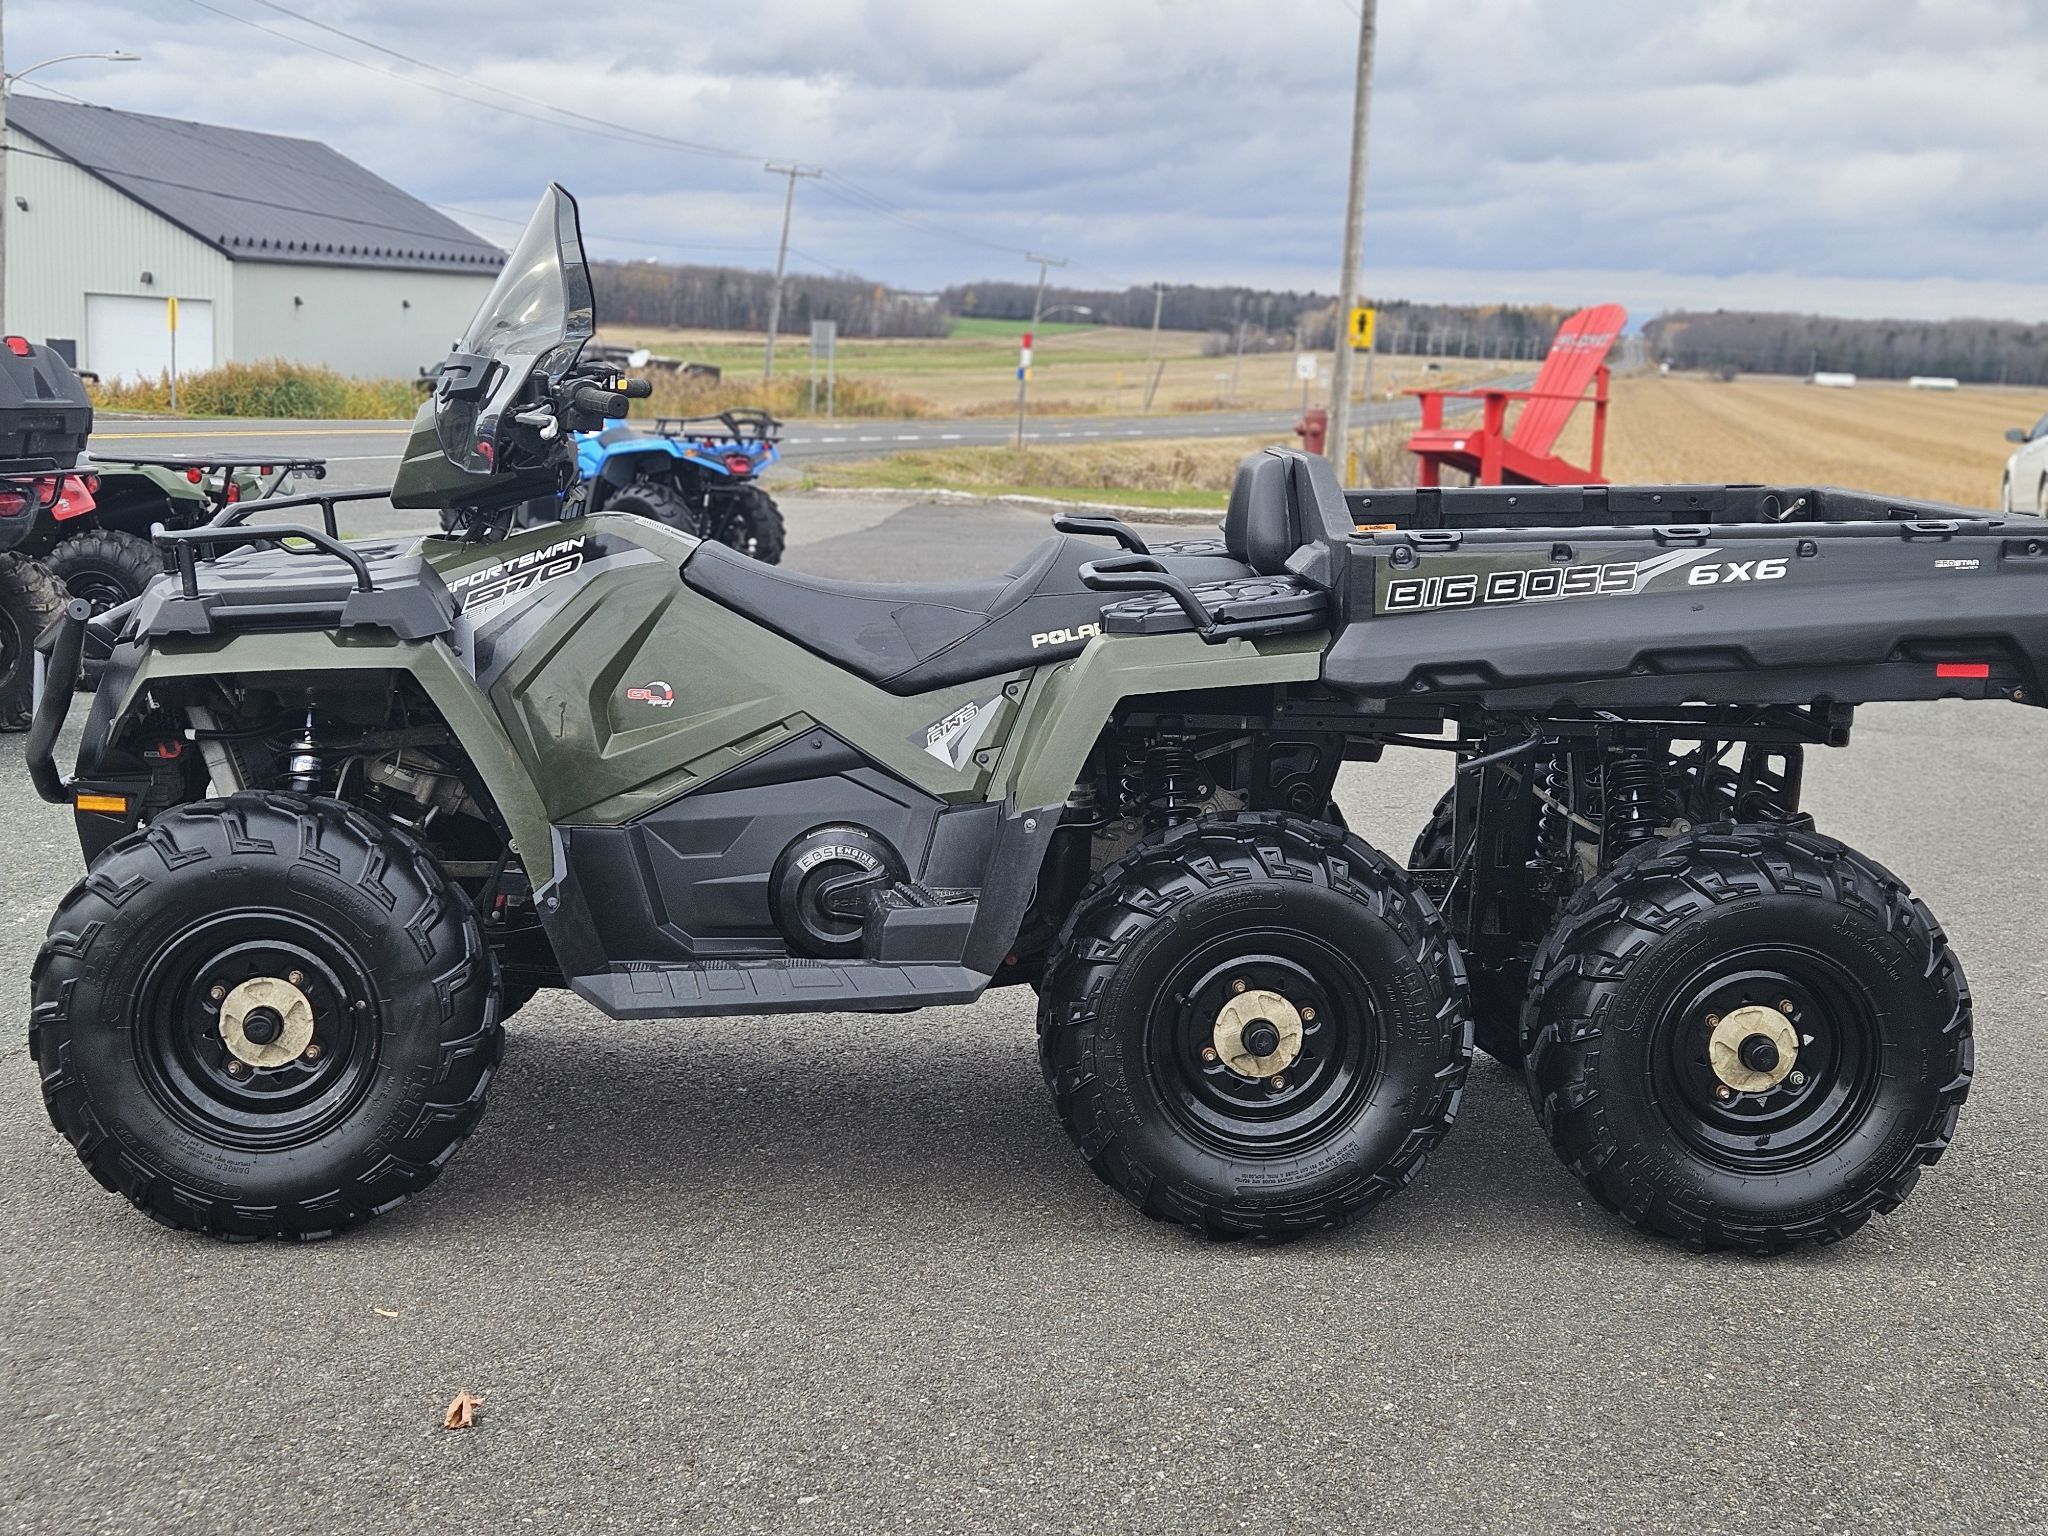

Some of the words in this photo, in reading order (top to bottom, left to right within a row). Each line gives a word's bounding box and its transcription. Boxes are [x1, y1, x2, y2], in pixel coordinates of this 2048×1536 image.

[446, 535, 587, 594] SPORTSMAN
[461, 553, 584, 614] 570
[1385, 574, 1478, 610] BIG
[1484, 562, 1640, 603] BOSS
[1688, 557, 1790, 586] 6X6
[926, 705, 979, 748] AWD
[801, 846, 834, 868] EBS
[836, 846, 877, 867] ENGINE
